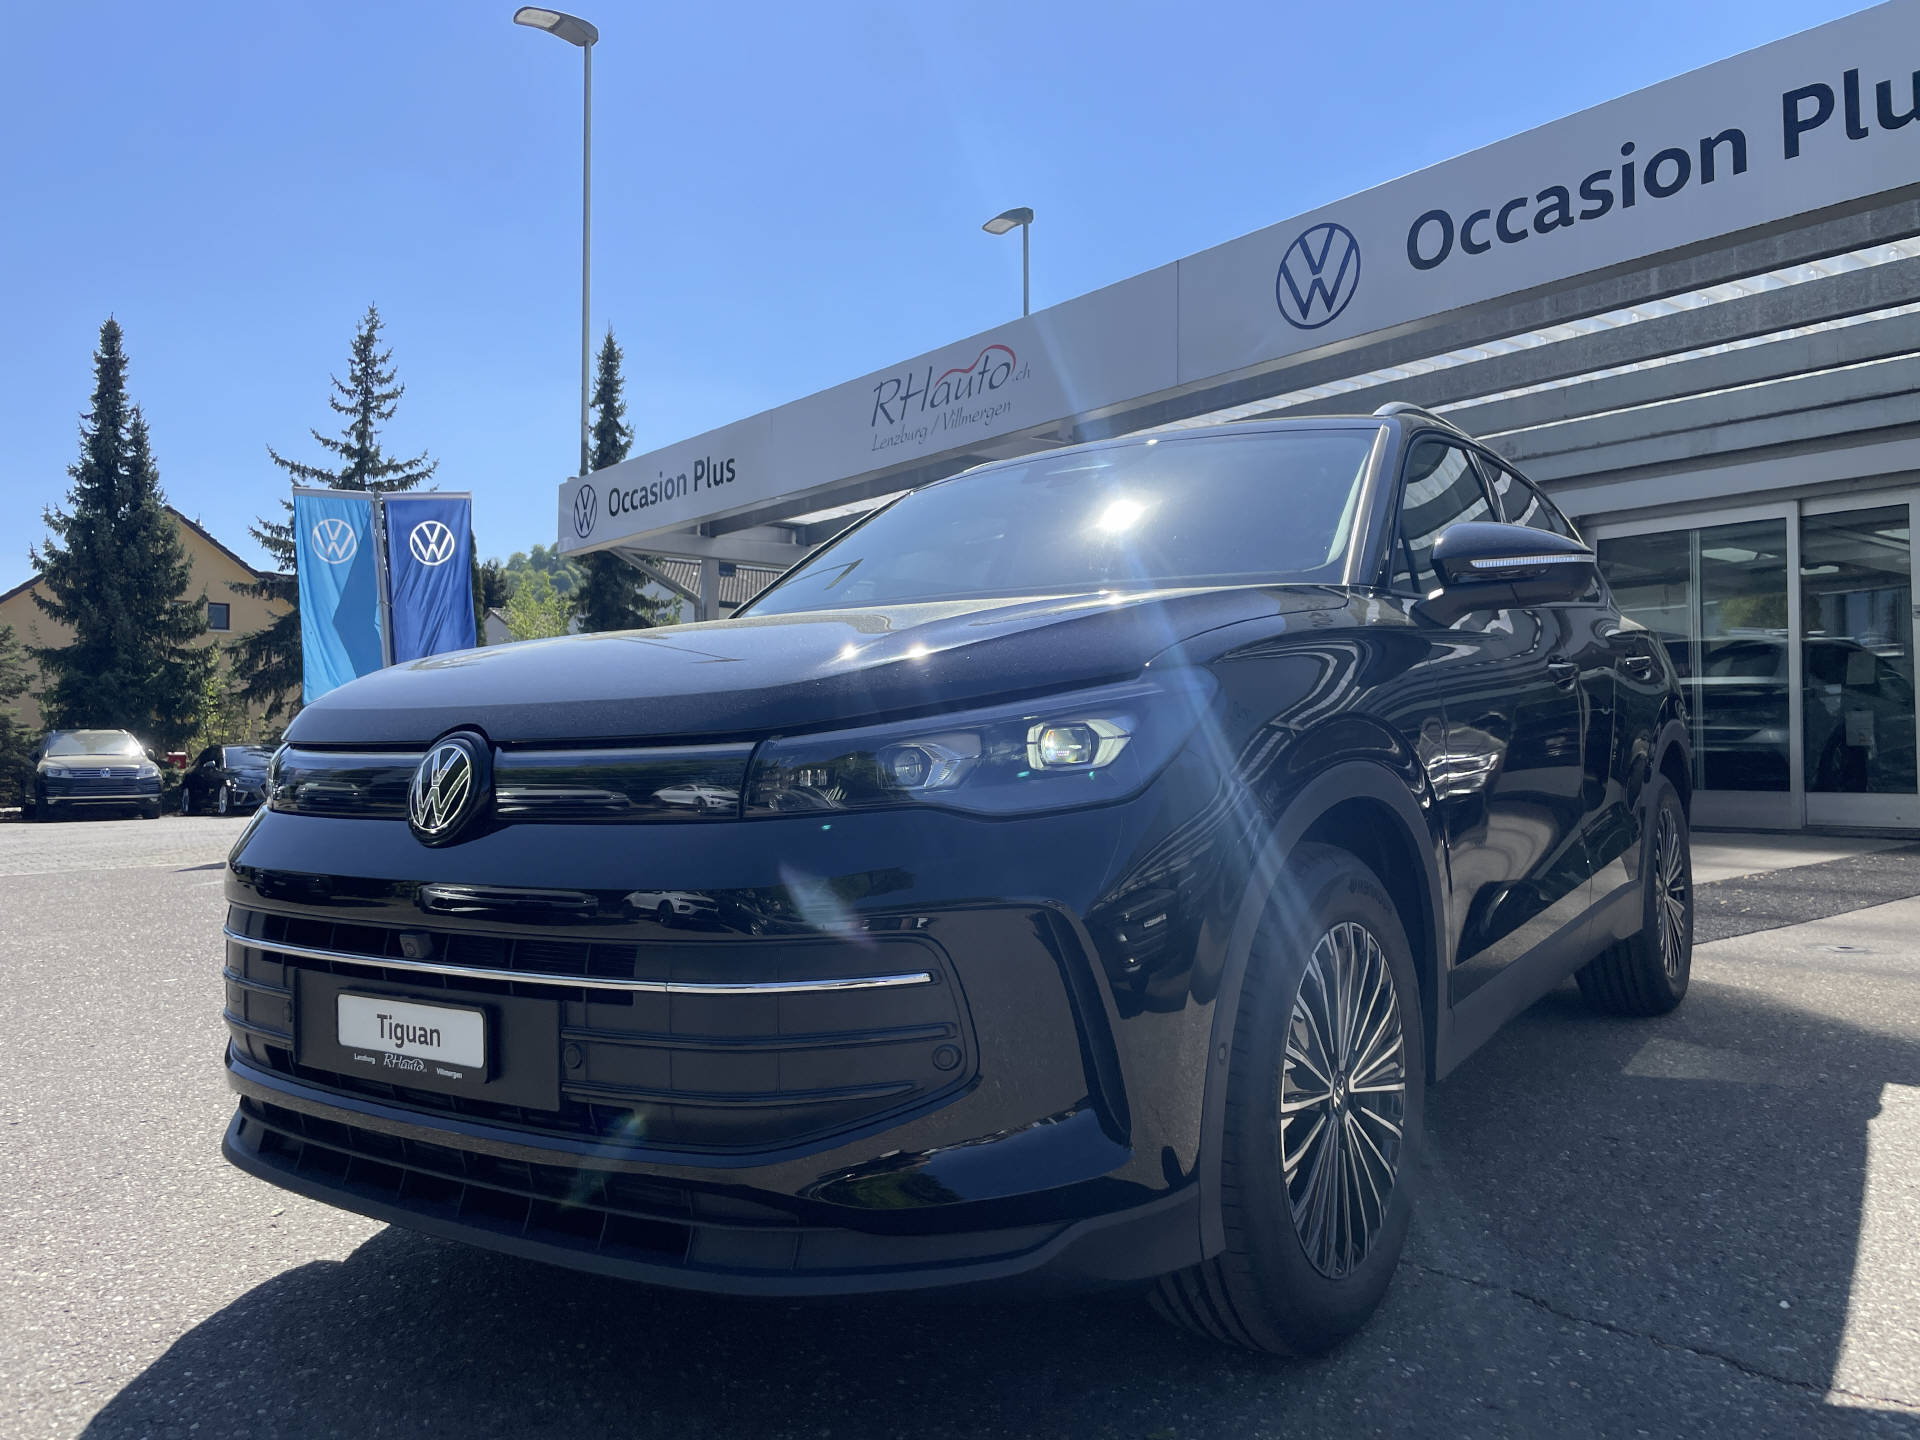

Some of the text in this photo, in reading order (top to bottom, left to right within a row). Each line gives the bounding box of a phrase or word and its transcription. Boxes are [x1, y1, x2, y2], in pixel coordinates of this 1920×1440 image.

[1406, 128, 1748, 271] Occasion
[1782, 67, 1920, 160] Plu
[872, 424, 928, 451] Lenzburg
[943, 400, 1011, 431] Villmergen
[608, 471, 687, 517] Occasion
[693, 456, 736, 492] Plus
[377, 1013, 441, 1048] Tiguan
